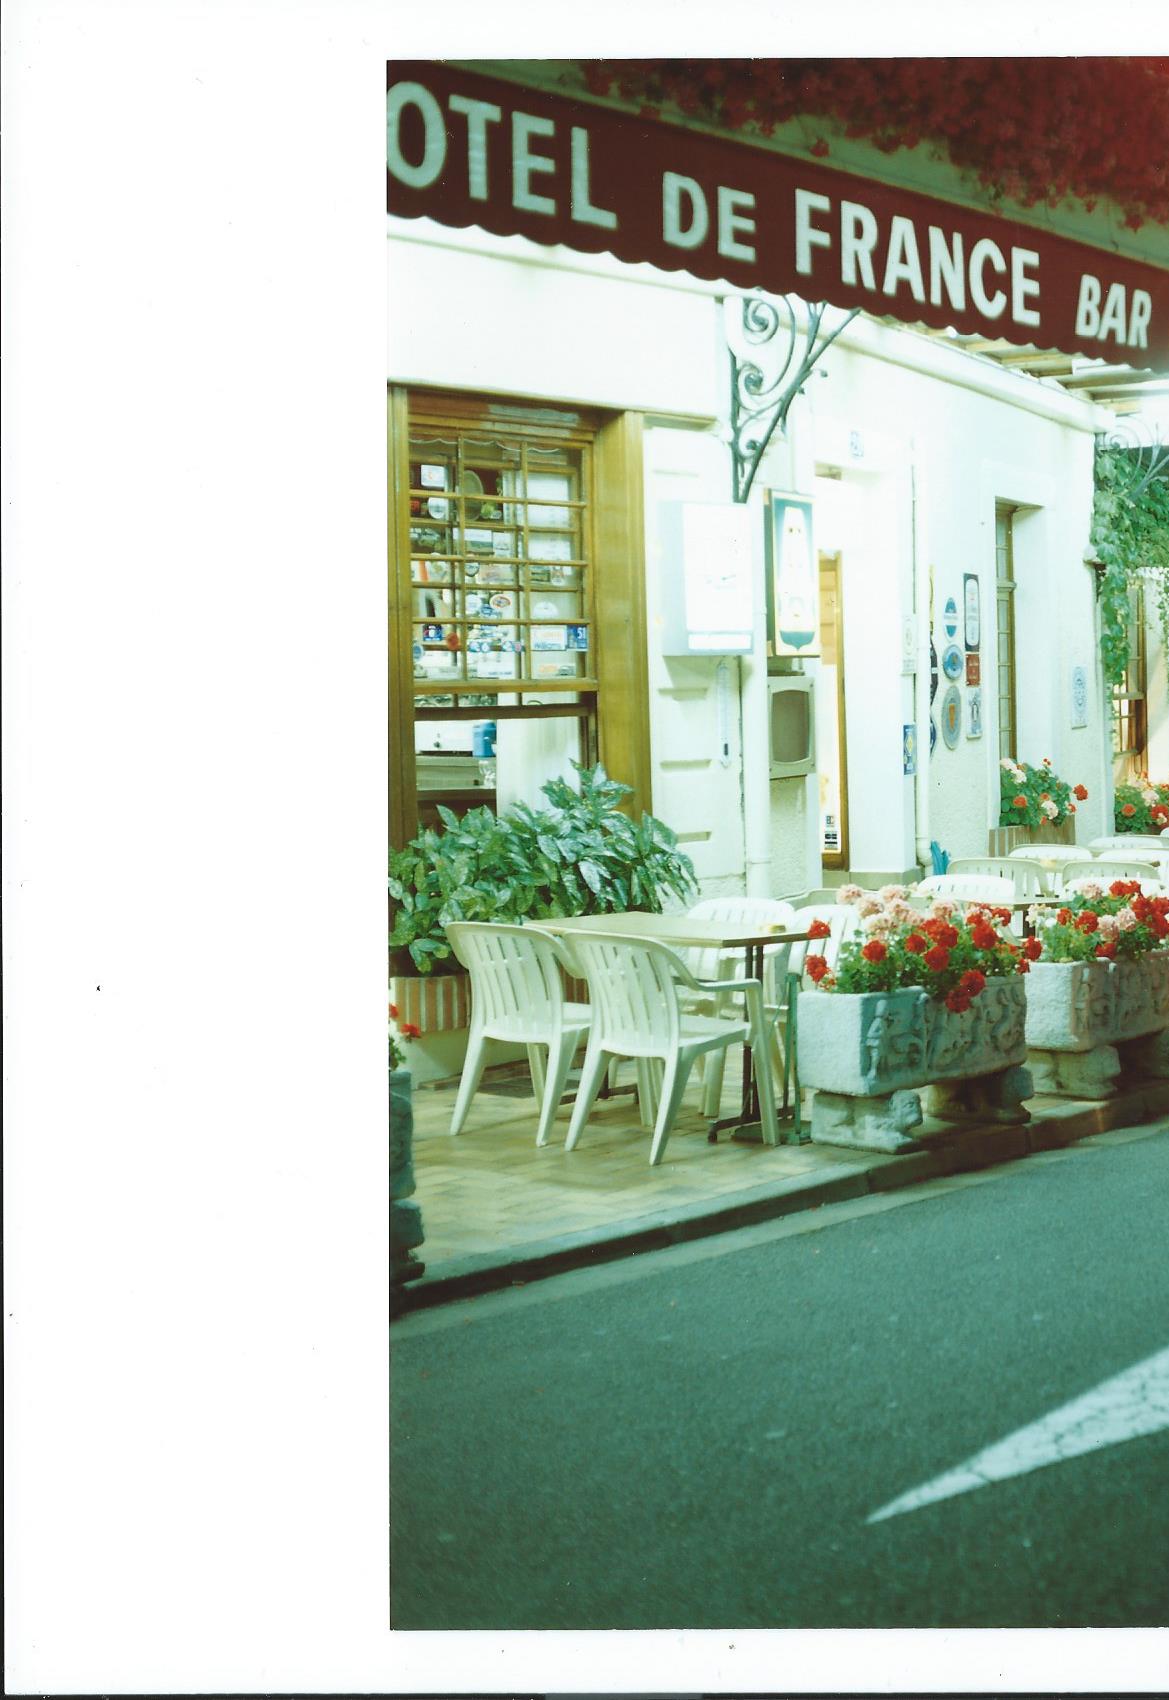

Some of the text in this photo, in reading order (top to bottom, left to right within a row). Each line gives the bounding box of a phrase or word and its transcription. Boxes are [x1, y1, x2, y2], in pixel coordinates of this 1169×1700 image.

[387, 80, 1153, 349] OTEL DE FRANCE BAR
